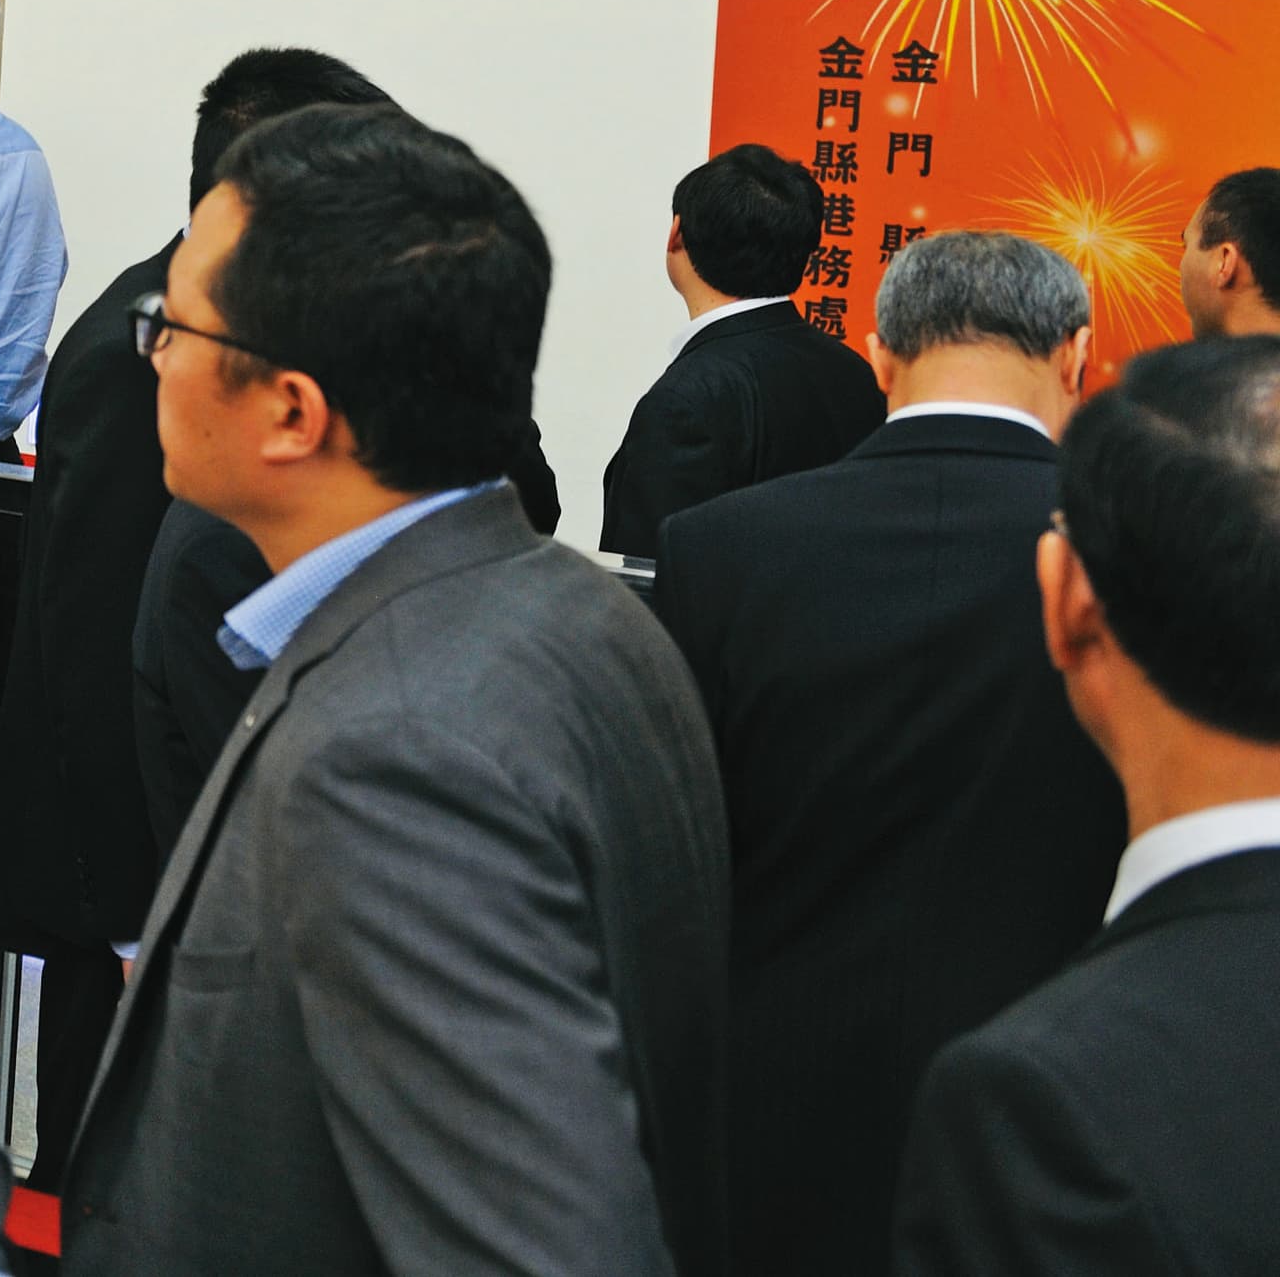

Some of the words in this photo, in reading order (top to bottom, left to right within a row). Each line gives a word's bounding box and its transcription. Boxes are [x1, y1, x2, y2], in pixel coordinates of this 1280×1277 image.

[803, 35, 865, 341] 金門縣港務處
